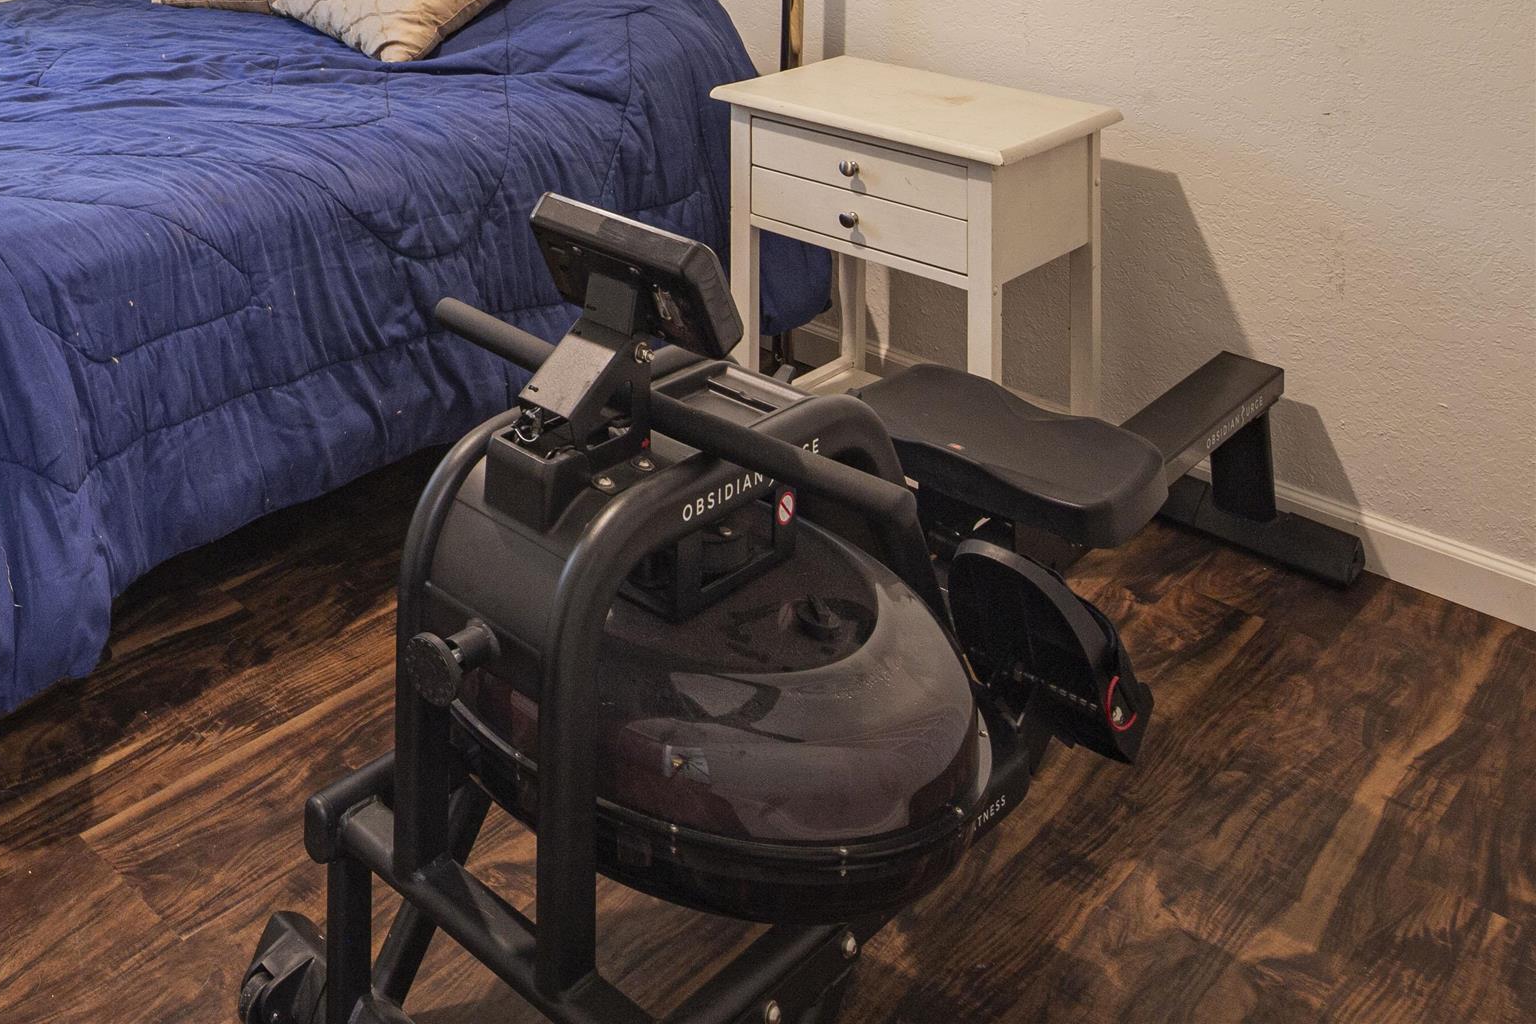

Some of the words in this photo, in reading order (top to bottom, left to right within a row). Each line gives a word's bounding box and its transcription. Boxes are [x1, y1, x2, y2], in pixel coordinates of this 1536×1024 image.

[1206, 414, 1240, 449] OBSIDIAN
[682, 472, 763, 522] OBSIDIAN
[974, 794, 1006, 832] TNESS
